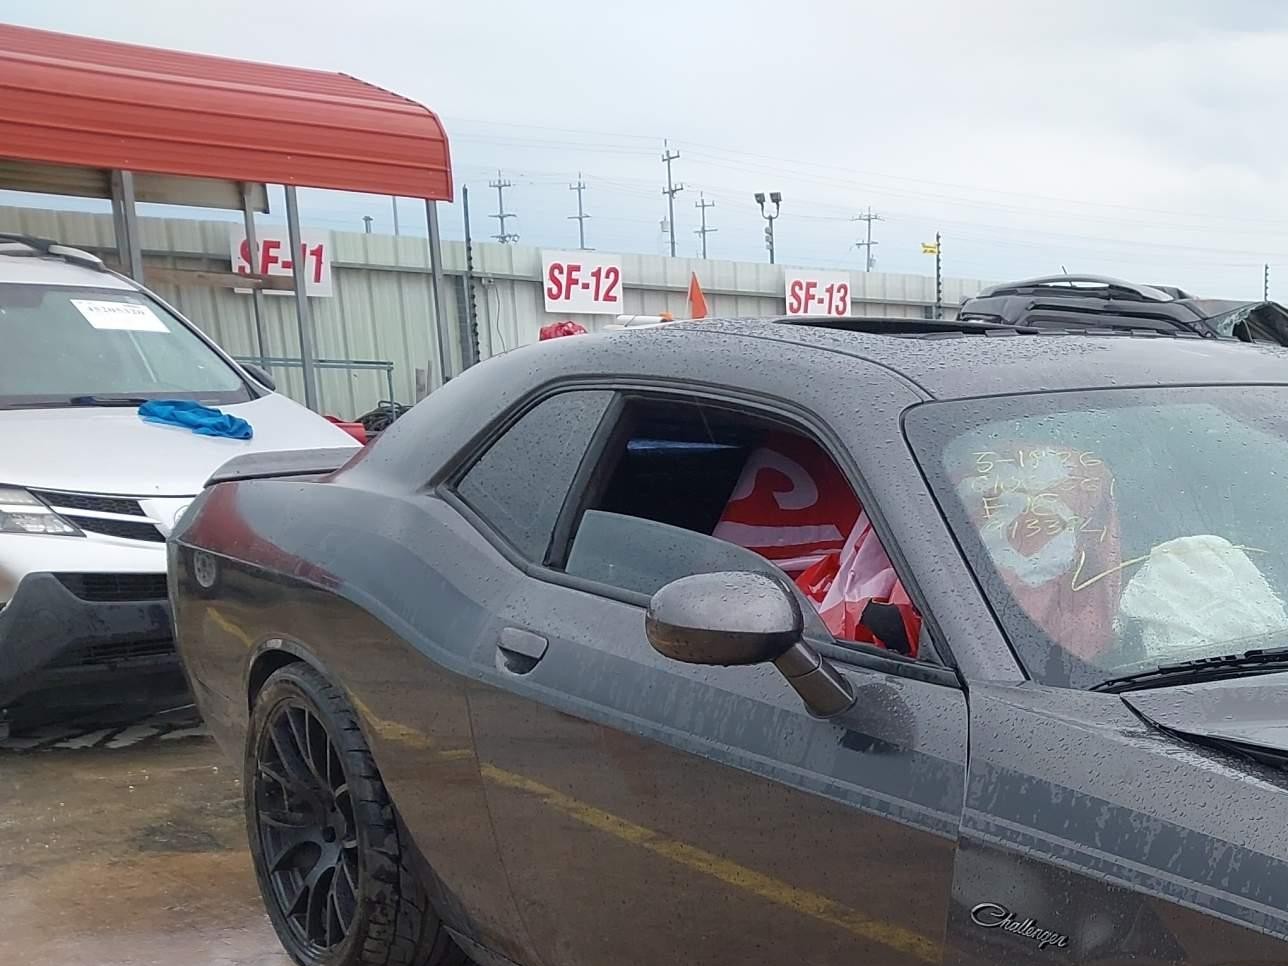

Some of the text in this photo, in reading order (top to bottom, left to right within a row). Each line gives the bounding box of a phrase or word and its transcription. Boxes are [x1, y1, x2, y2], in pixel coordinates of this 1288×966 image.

[547, 262, 620, 302] SF-12
[788, 280, 849, 315] SF-13
[970, 902, 1069, 949] Challenger
